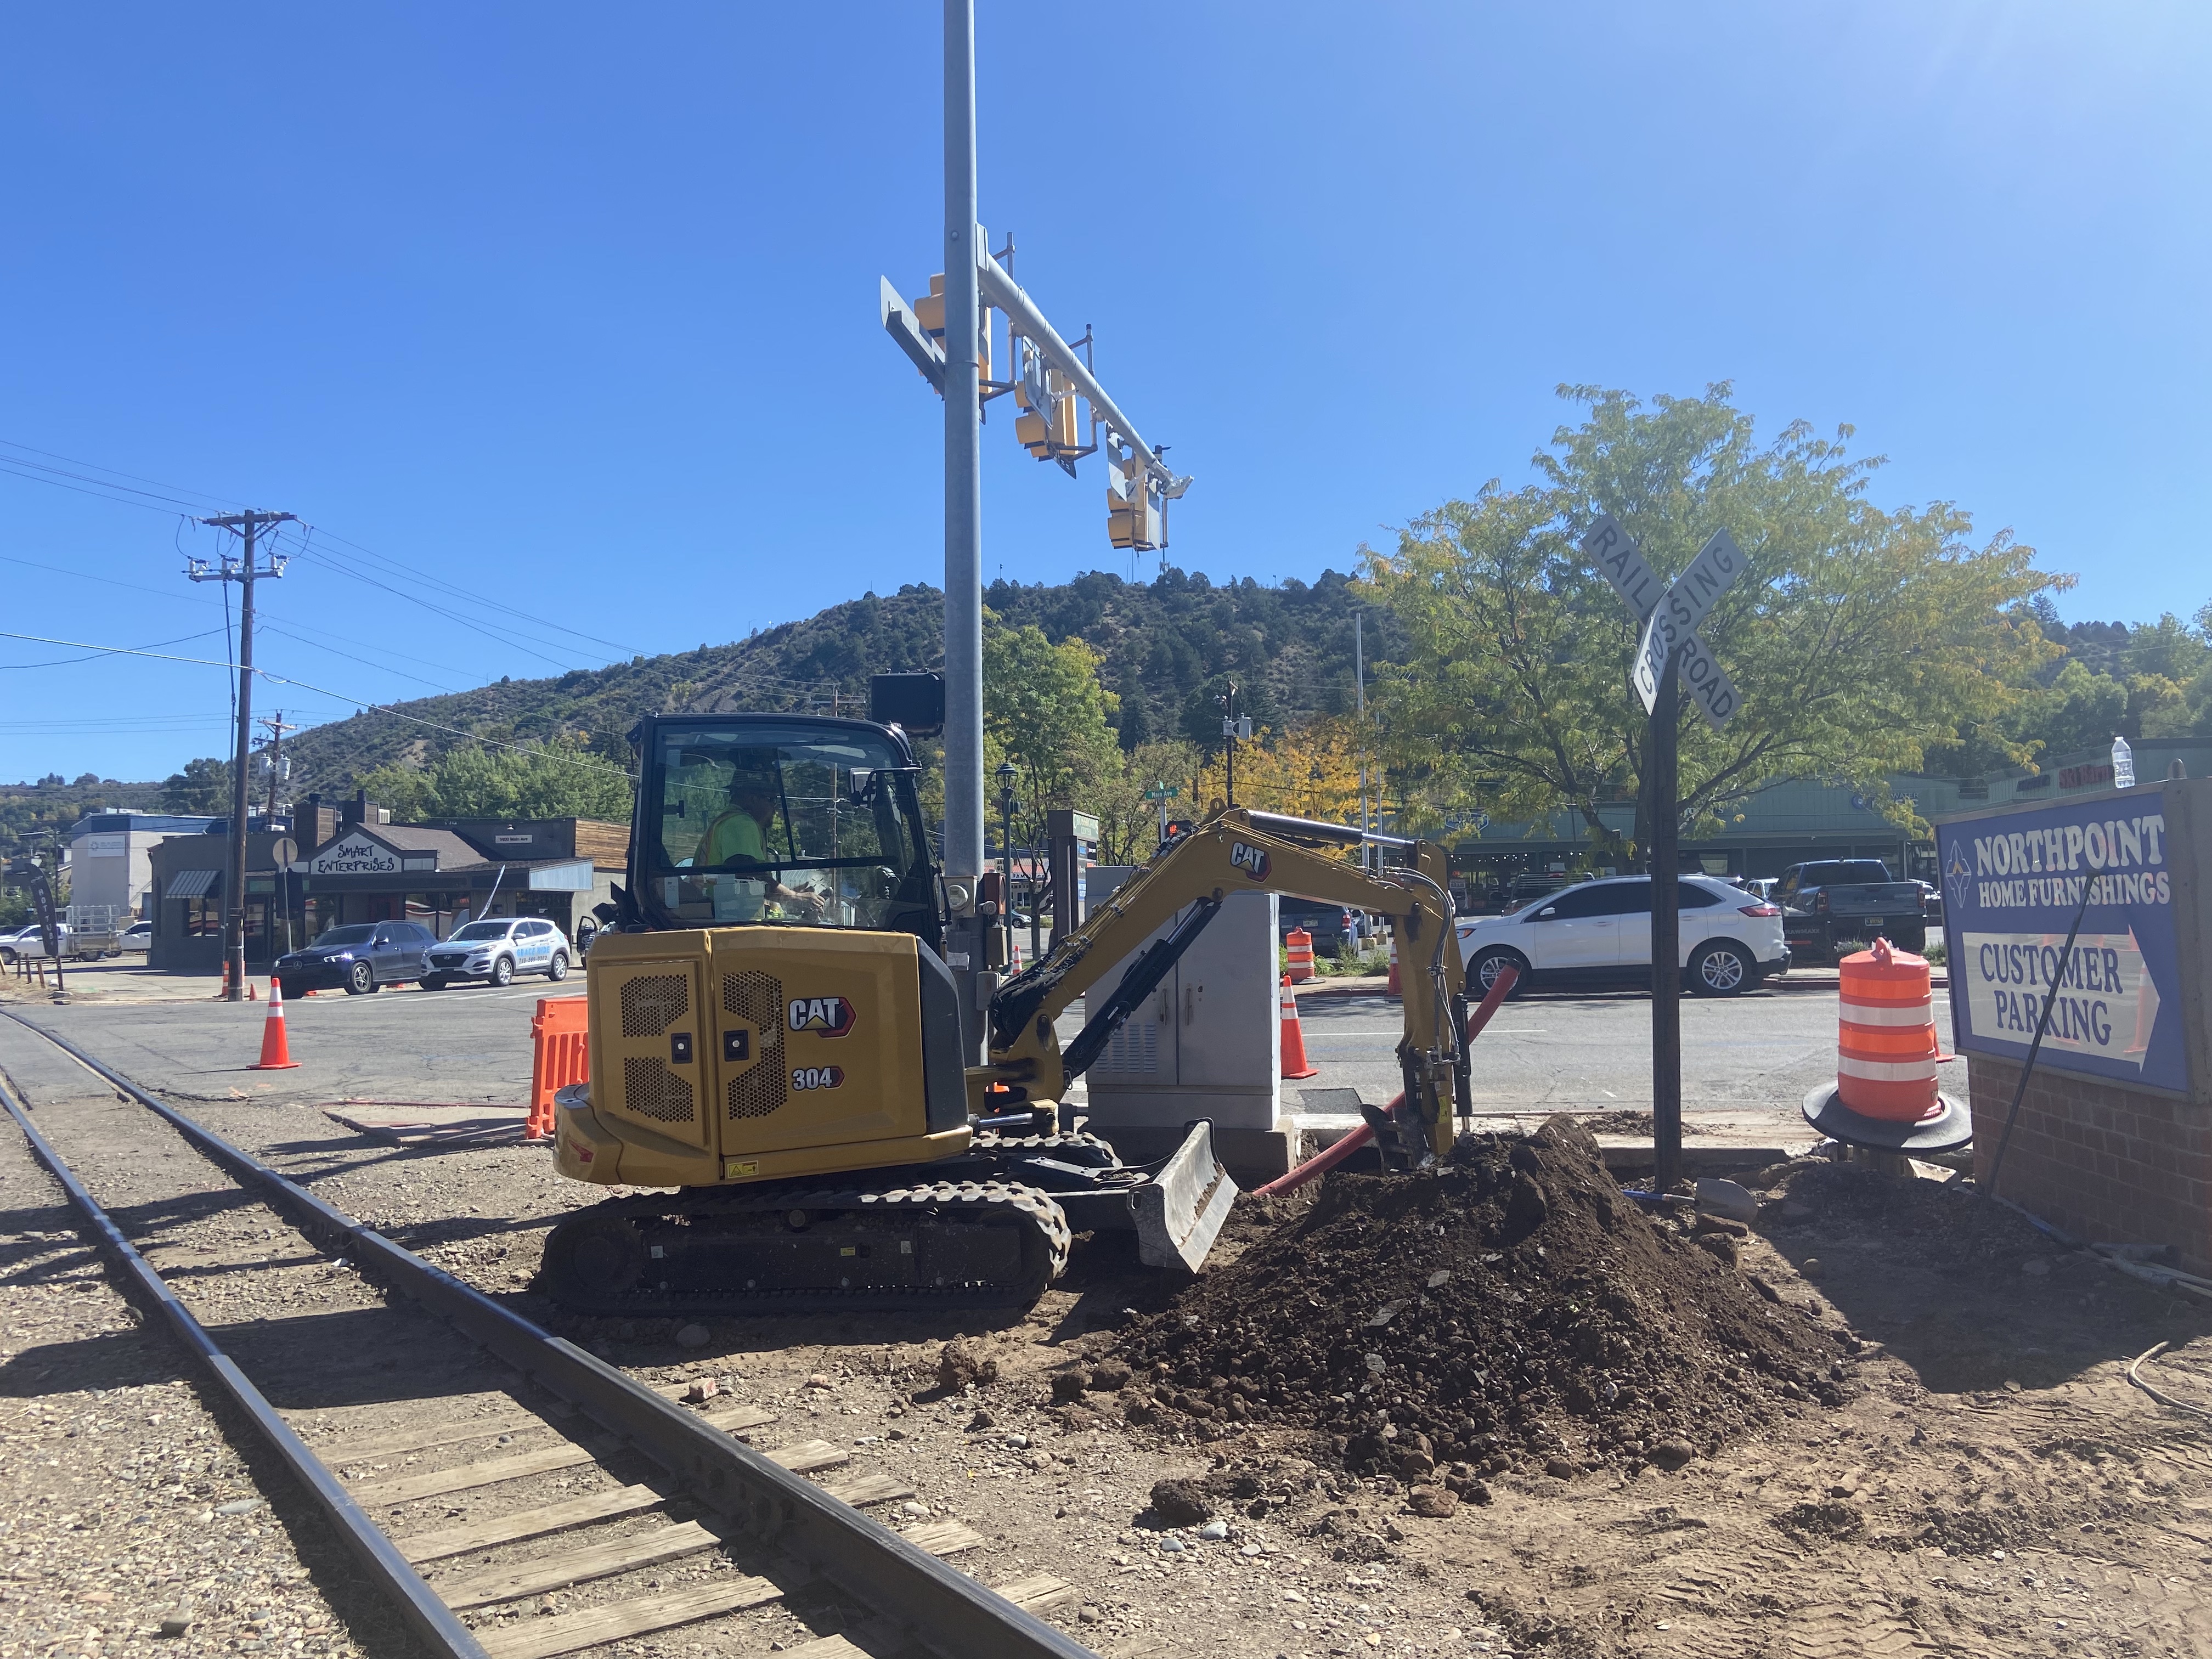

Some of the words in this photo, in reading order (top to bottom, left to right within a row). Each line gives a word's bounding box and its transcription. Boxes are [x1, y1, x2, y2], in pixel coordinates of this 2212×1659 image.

[1593, 524, 1649, 608] RAIL
[1680, 636, 1733, 718] ROAD
[1640, 547, 1733, 695] CROSSING
[338, 844, 374, 858] SMART
[1231, 842, 1265, 873] CAT
[1974, 814, 2164, 877] NORTHPOINT
[38, 888, 47, 912] HOT
[1978, 879, 2027, 908] HOME
[1980, 943, 2123, 994] CUSTOMER
[790, 998, 839, 1030] CAT
[1994, 990, 2112, 1046] PARKING
[793, 1068, 832, 1090] 304
